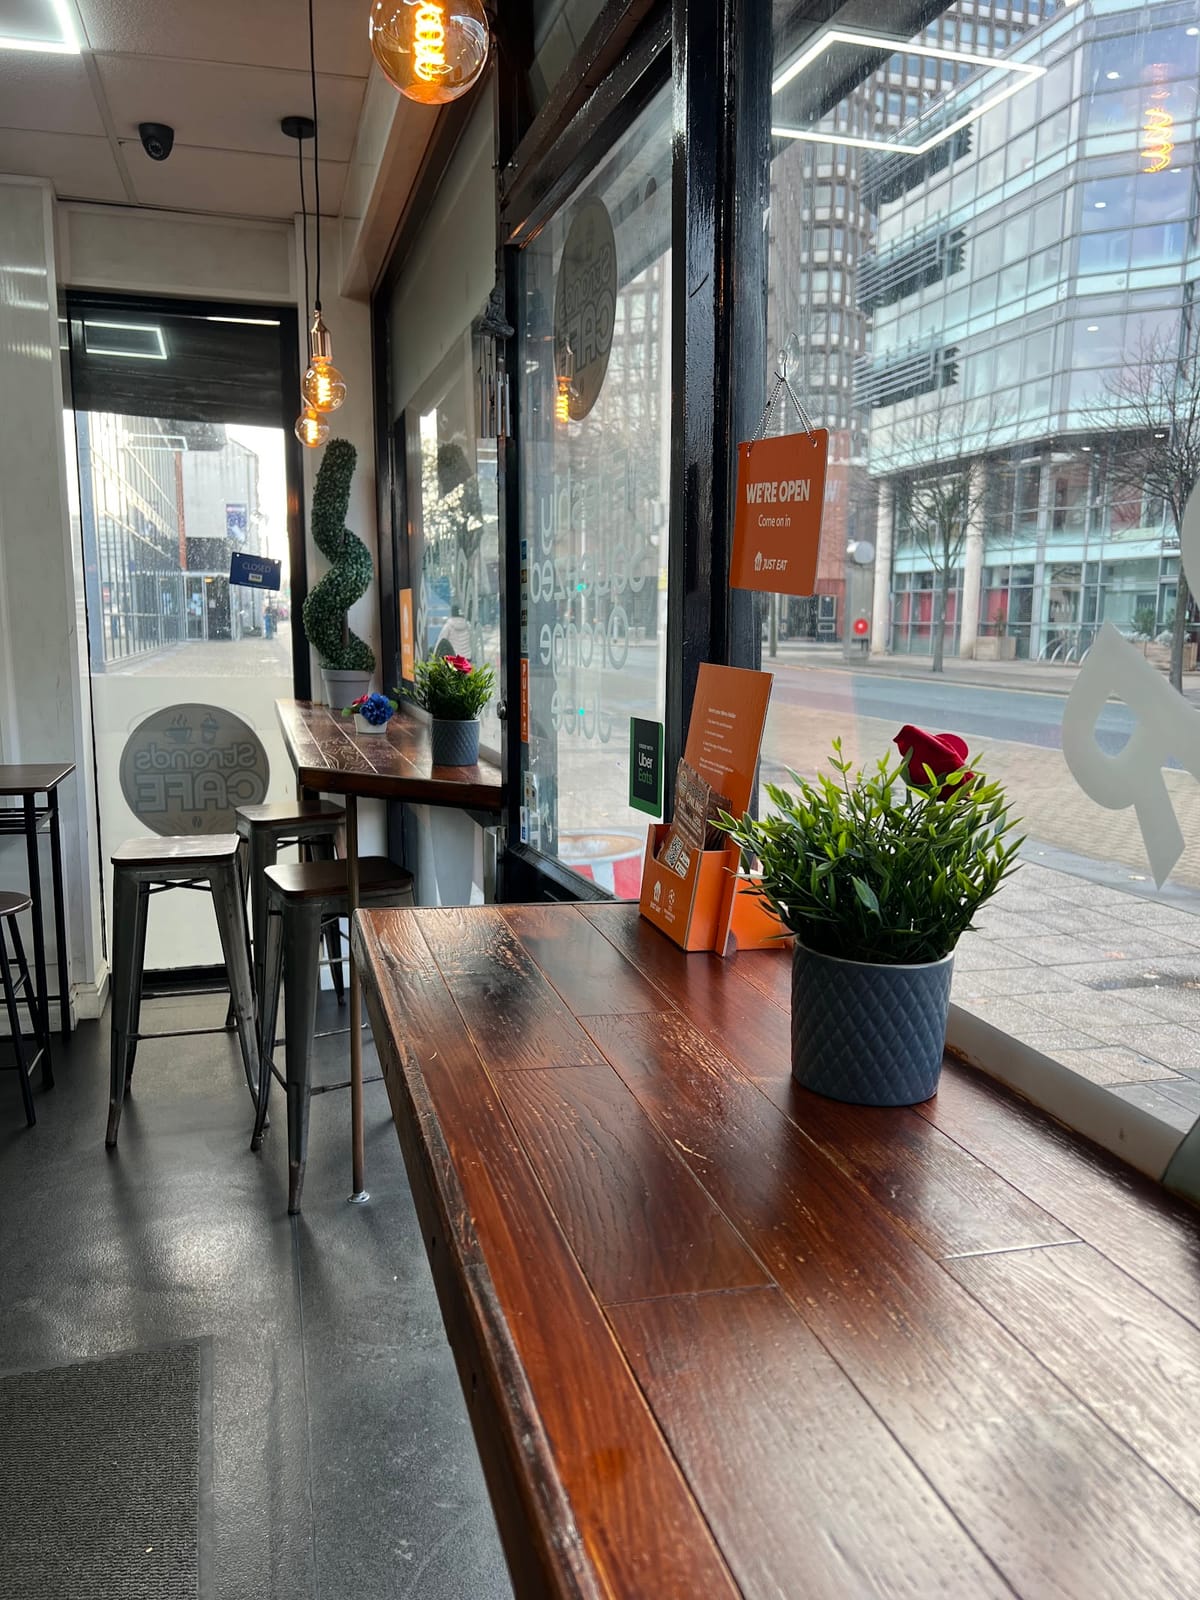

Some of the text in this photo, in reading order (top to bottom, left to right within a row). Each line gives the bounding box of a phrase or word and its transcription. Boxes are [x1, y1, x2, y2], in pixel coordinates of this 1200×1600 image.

[746, 481, 778, 504] WE'RE
[778, 479, 811, 502] OPEN
[757, 514, 791, 528] Come on in
[762, 559, 788, 572] JUST EAT
[638, 751, 654, 769] Uber
[638, 768, 653, 785] Eats
